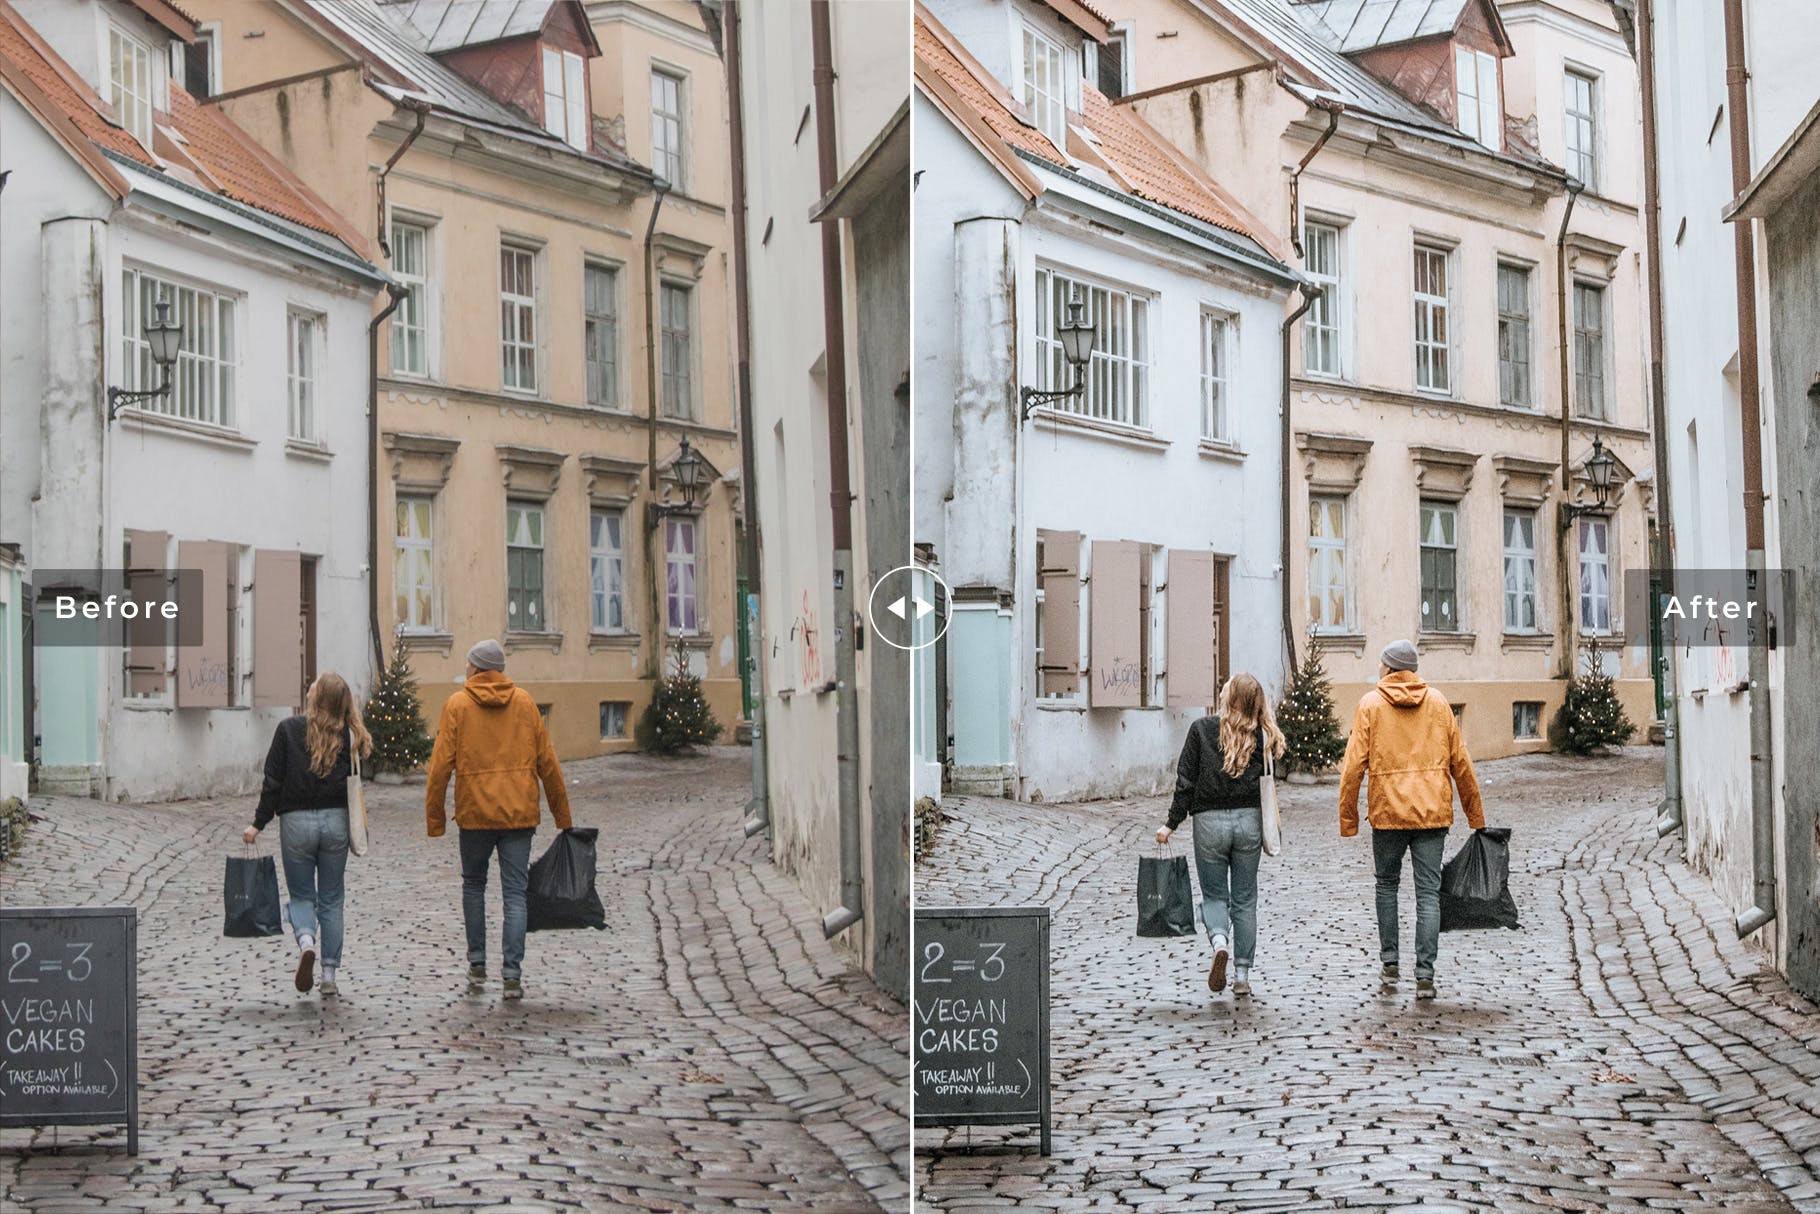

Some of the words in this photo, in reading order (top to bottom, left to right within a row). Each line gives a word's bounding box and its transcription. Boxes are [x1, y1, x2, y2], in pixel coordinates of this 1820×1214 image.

[1, 997, 93, 1025] VEGAN
[914, 997, 1006, 1025] VEGAN
[6, 1028, 85, 1053] CAKES
[919, 1028, 998, 1053] CAKES
[22, 1085, 60, 1095] OPTION
[63, 1085, 108, 1095] AVAILABLE
[935, 1085, 973, 1095] OPTION
[976, 1085, 1021, 1095] AVAILABLE
